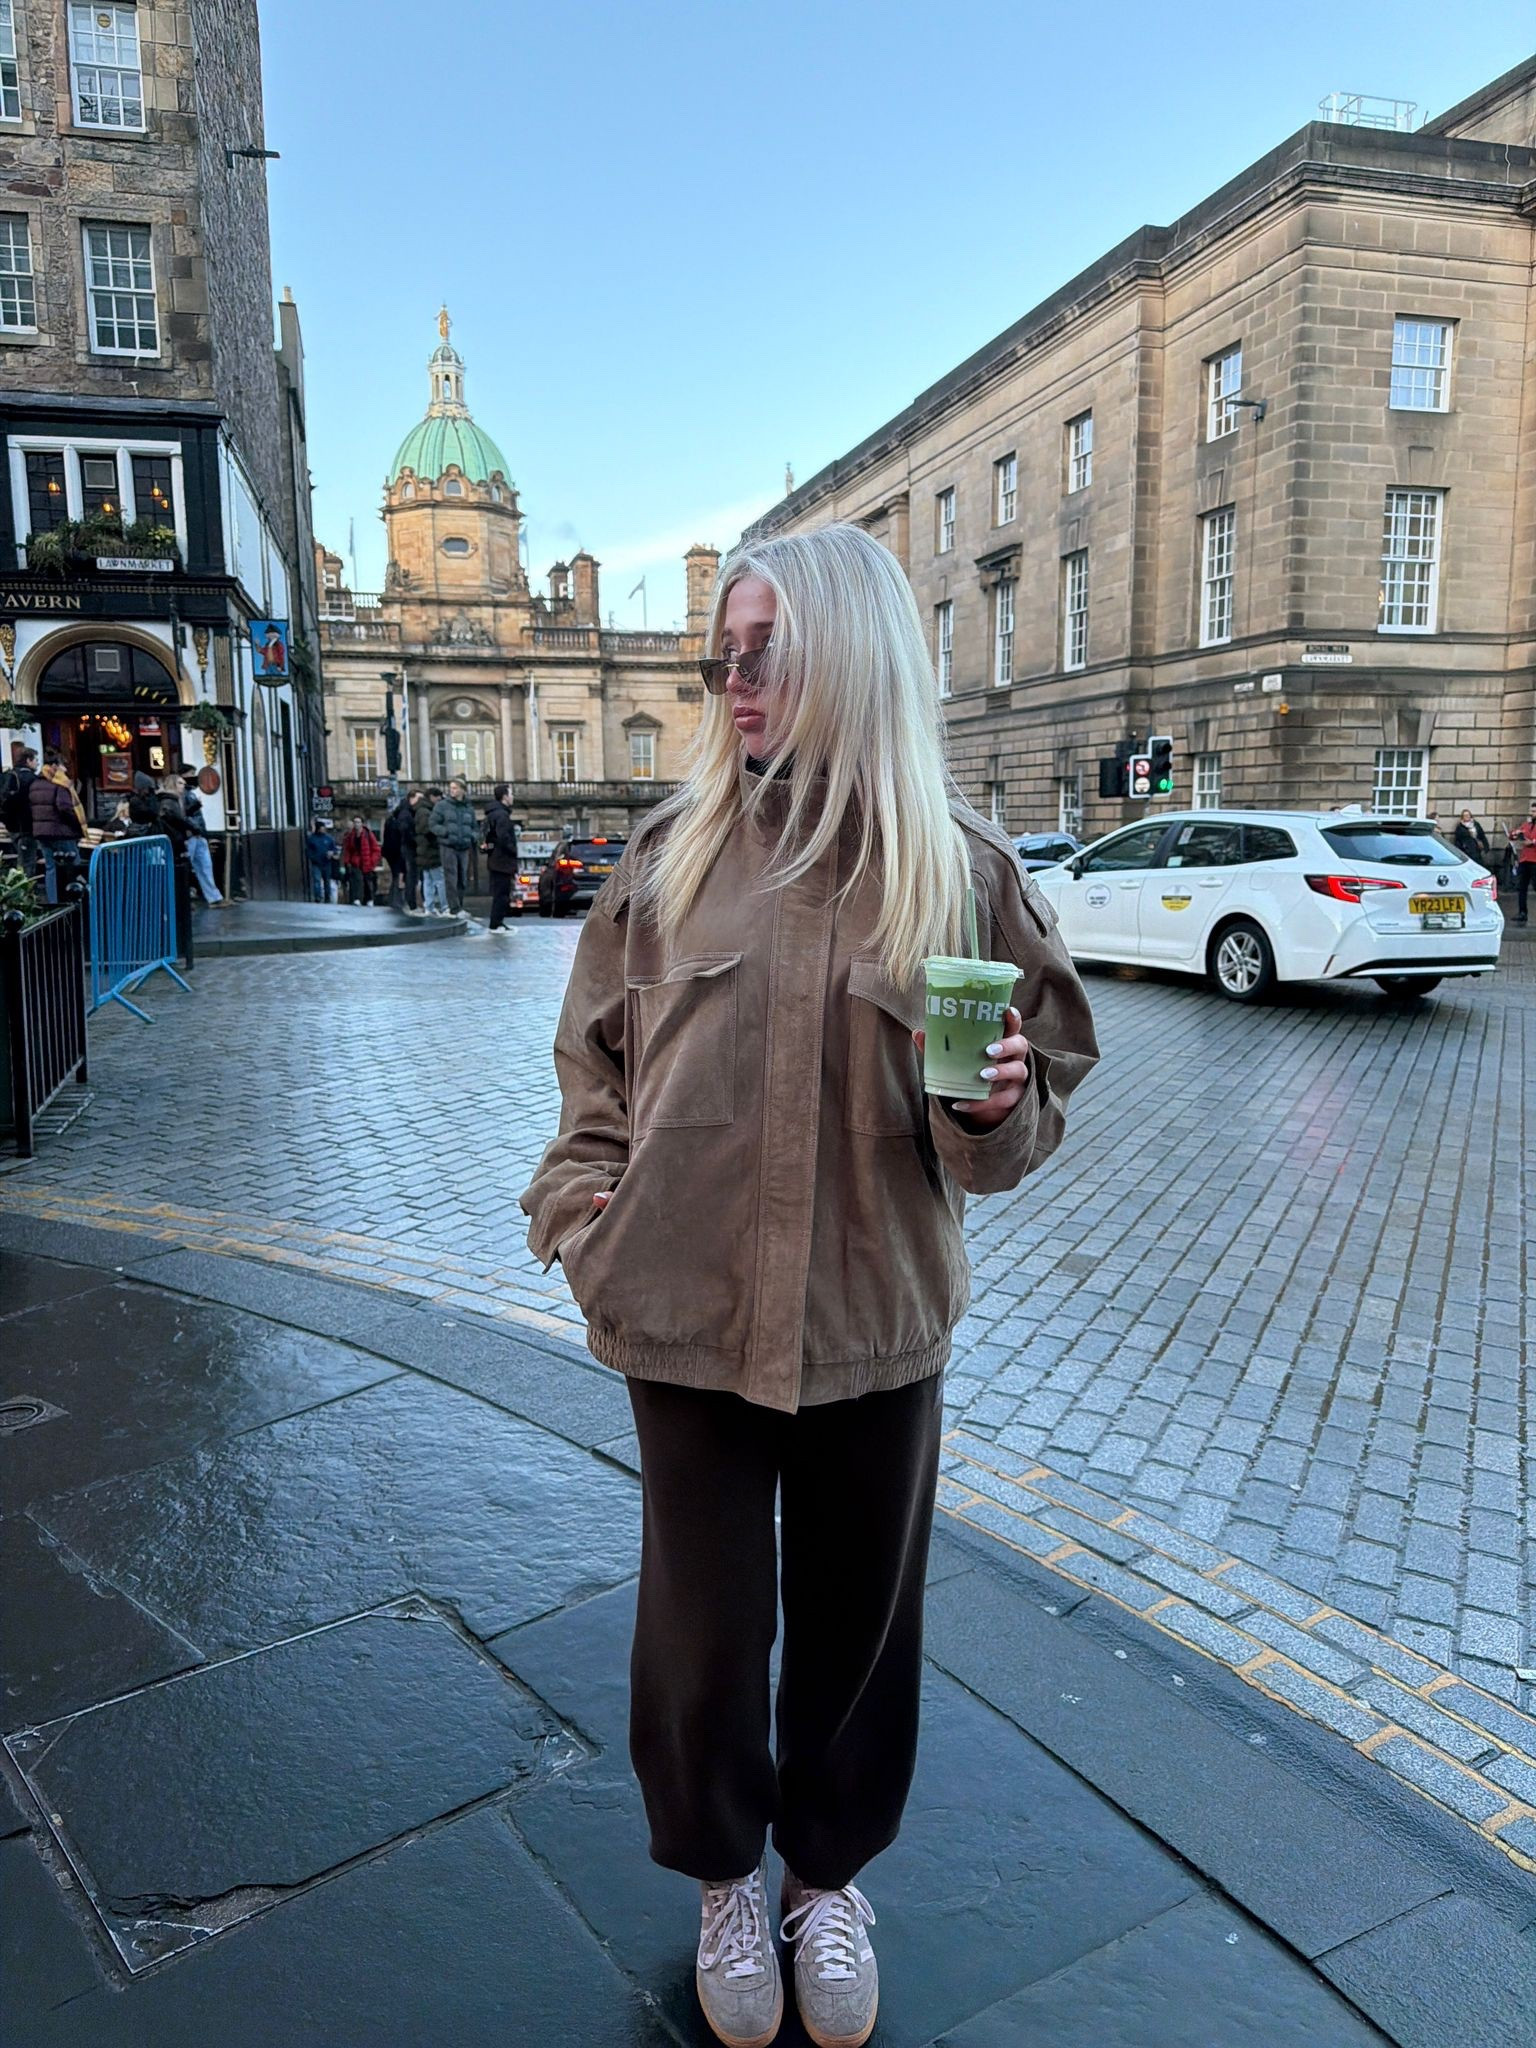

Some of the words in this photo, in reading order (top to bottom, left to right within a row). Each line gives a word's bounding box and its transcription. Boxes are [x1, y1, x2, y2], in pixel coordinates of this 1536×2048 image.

[99, 559, 170, 570] LAWNMARKET
[1413, 898, 1441, 912] YR23
[1443, 898, 1462, 911] LFA
